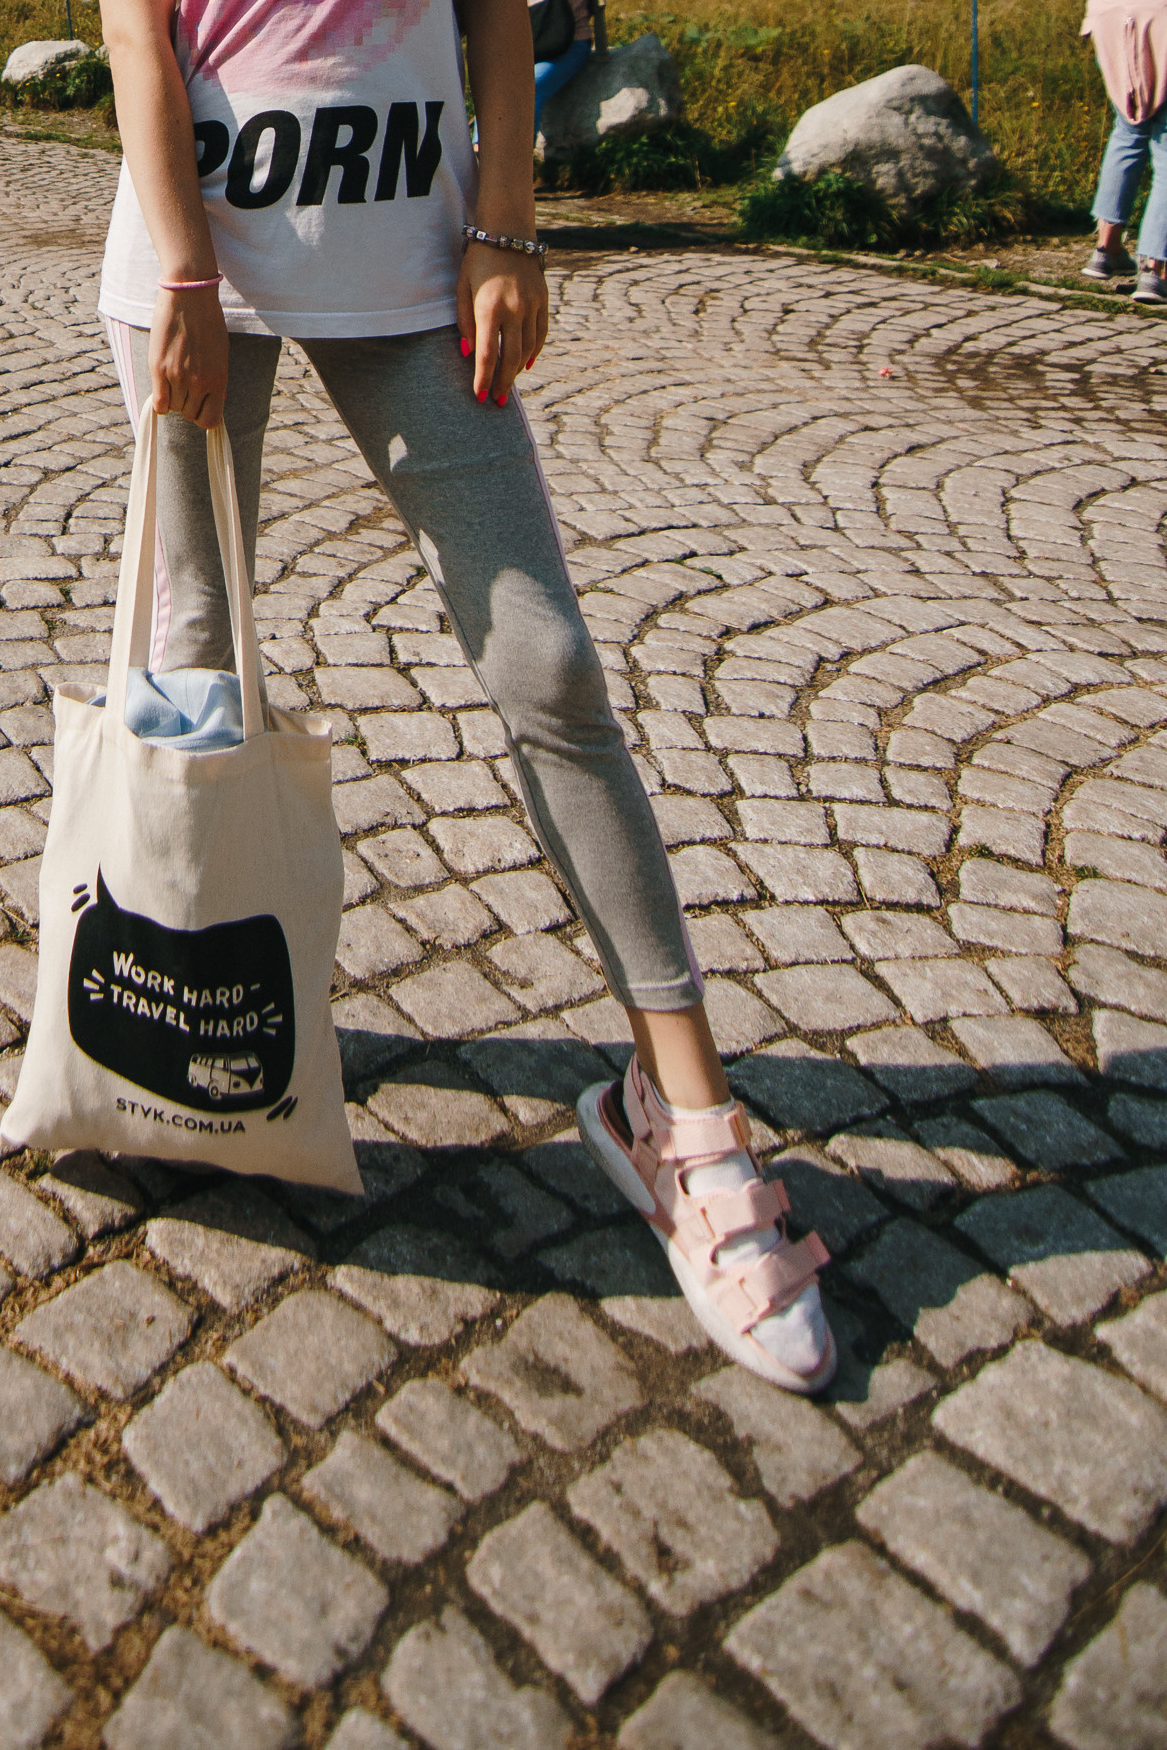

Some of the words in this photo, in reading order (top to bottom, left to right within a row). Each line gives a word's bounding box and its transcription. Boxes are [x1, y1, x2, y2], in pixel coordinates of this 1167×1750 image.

[113, 951, 175, 995] WORK
[183, 985, 243, 1008] HARD
[110, 984, 190, 1032] TRAVEL
[200, 1011, 258, 1038] HARD
[116, 1097, 246, 1134] STVK.COM.UA
